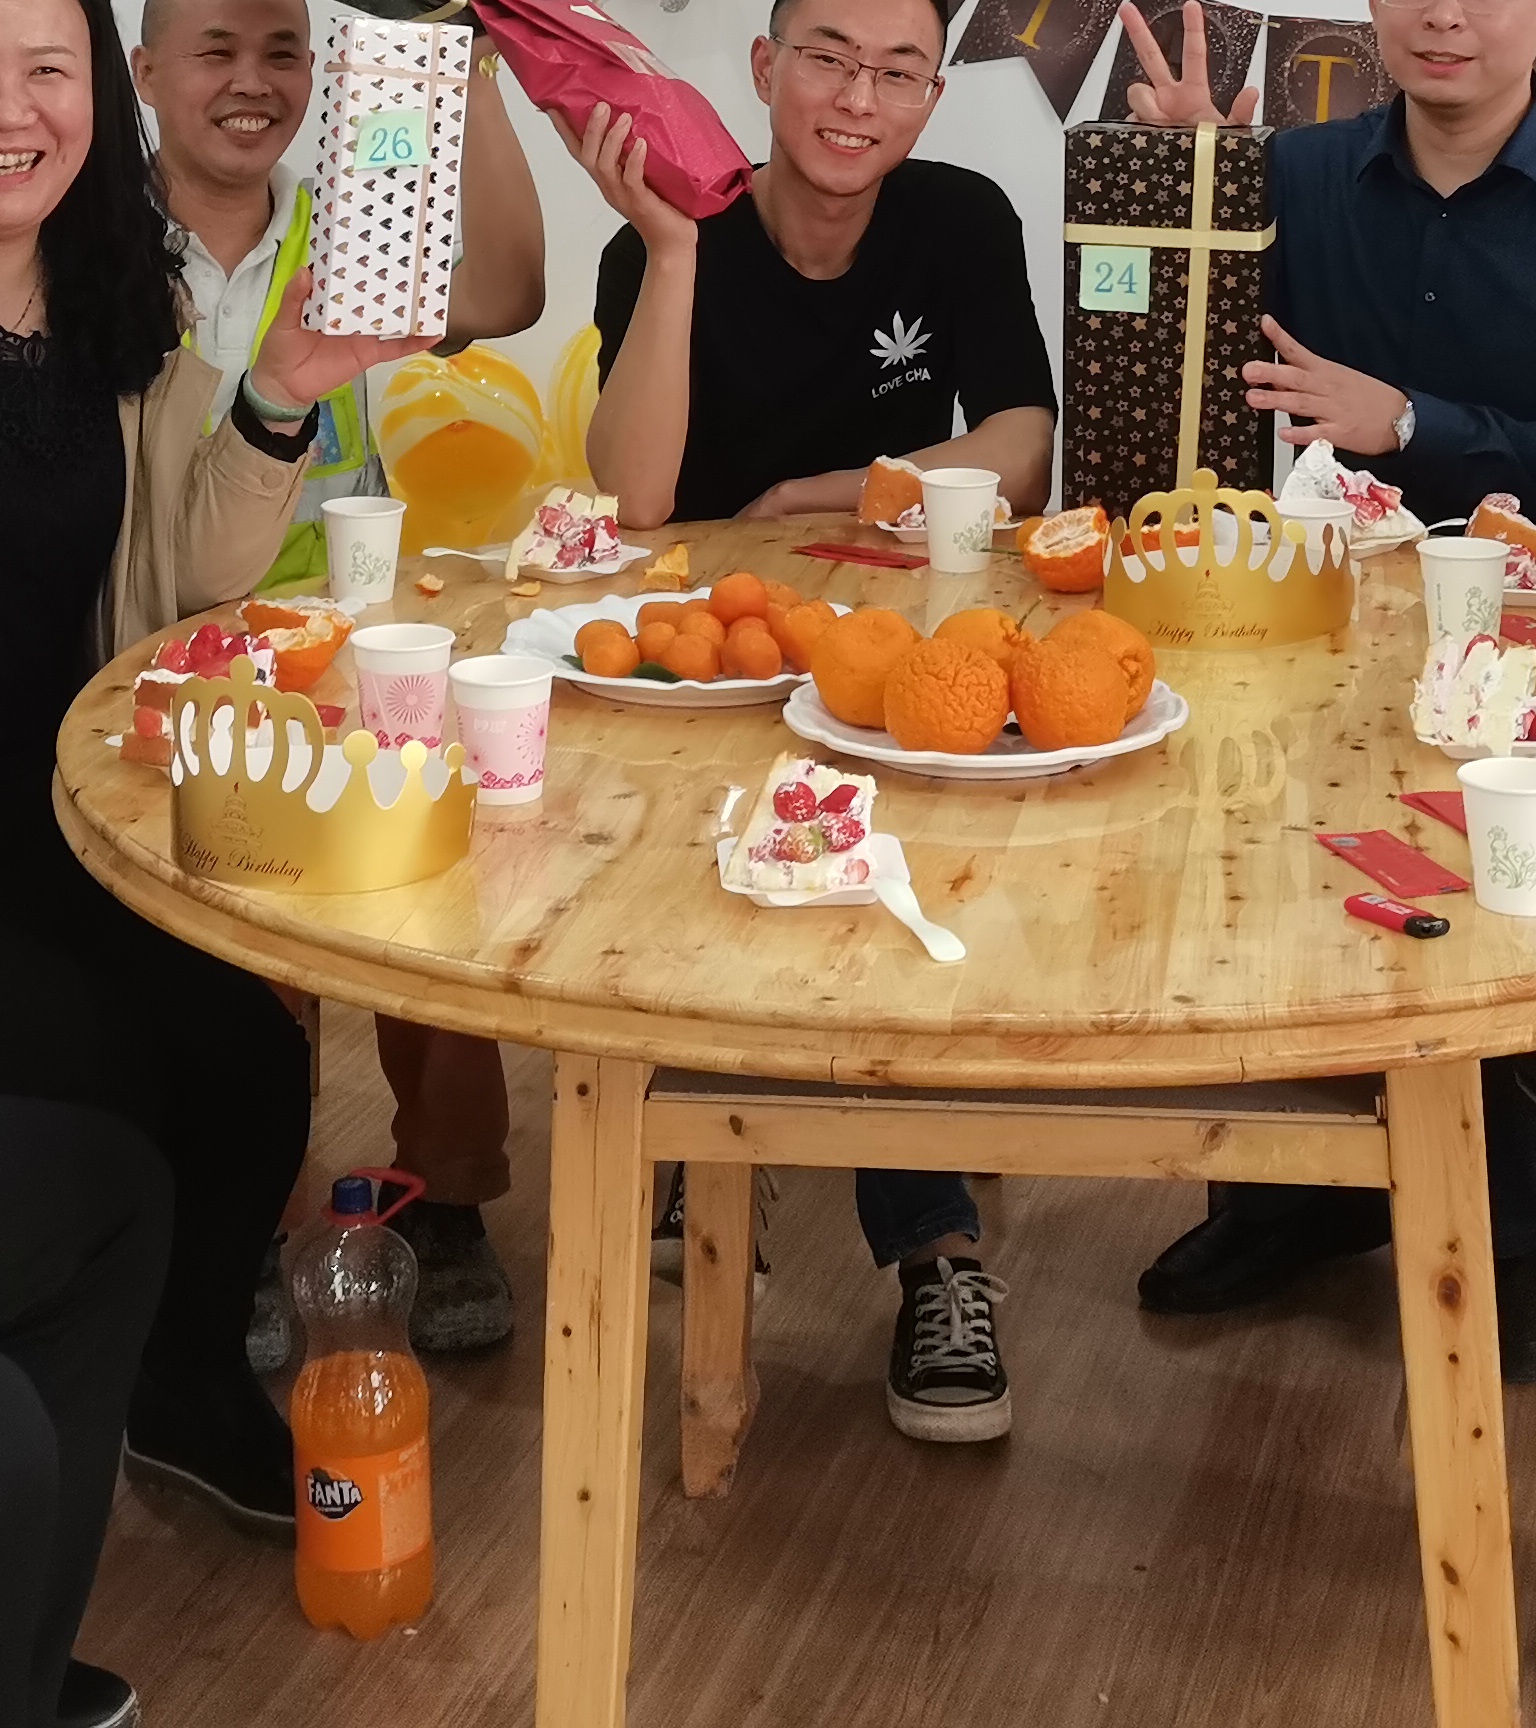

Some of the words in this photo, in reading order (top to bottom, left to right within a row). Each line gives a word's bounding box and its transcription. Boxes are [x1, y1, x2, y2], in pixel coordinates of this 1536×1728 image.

[367, 125, 414, 163] 26
[1093, 260, 1139, 296] 24
[871, 374, 905, 399] LOVE
[905, 367, 932, 383] CHA
[1147, 619, 1196, 644] Happy
[1204, 620, 1269, 642] Birthday
[181, 832, 220, 873] Happy
[227, 846, 305, 887] Birthday
[307, 1475, 363, 1506] FANTA
